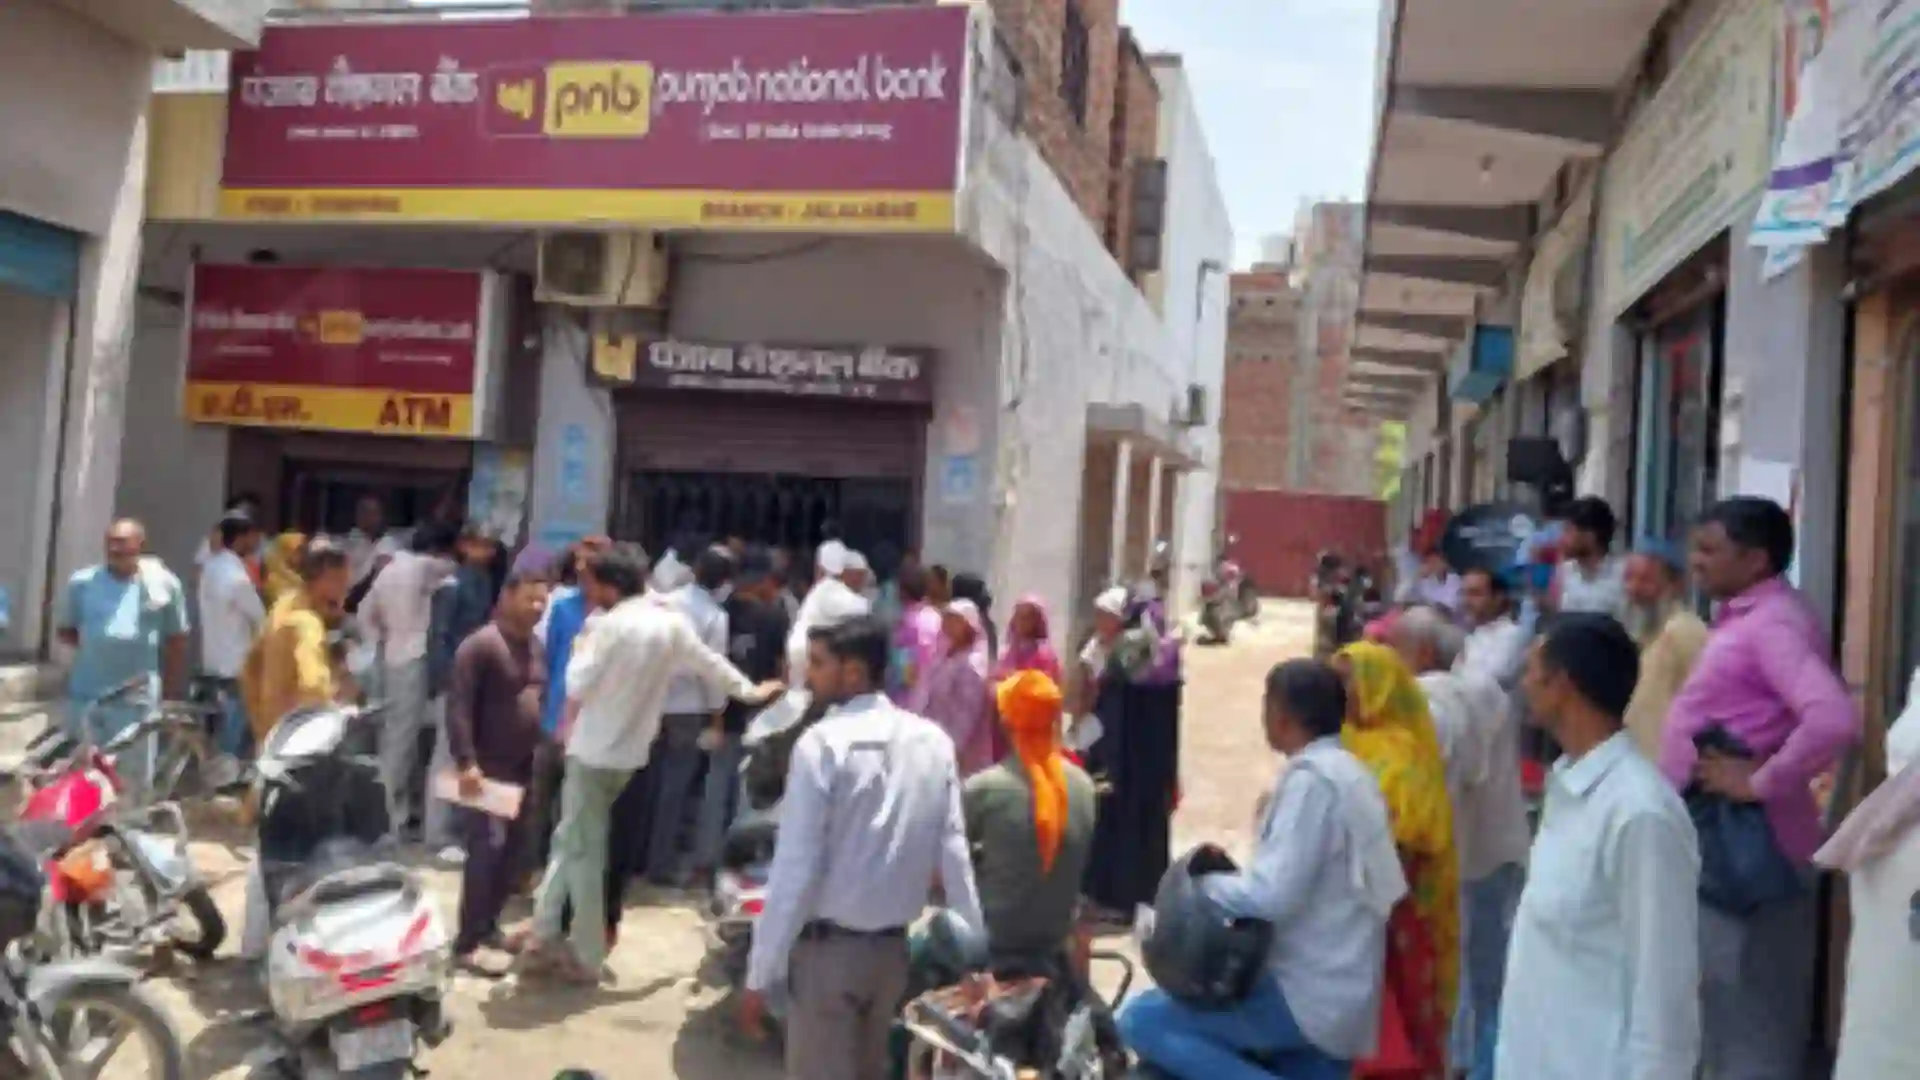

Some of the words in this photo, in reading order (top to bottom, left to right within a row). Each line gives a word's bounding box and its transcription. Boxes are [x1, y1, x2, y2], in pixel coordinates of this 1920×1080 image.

[555, 69, 641, 128] pnb
[652, 56, 749, 115] punjab
[755, 55, 869, 102] national
[874, 52, 946, 100] bank
[380, 396, 450, 428] ATM
